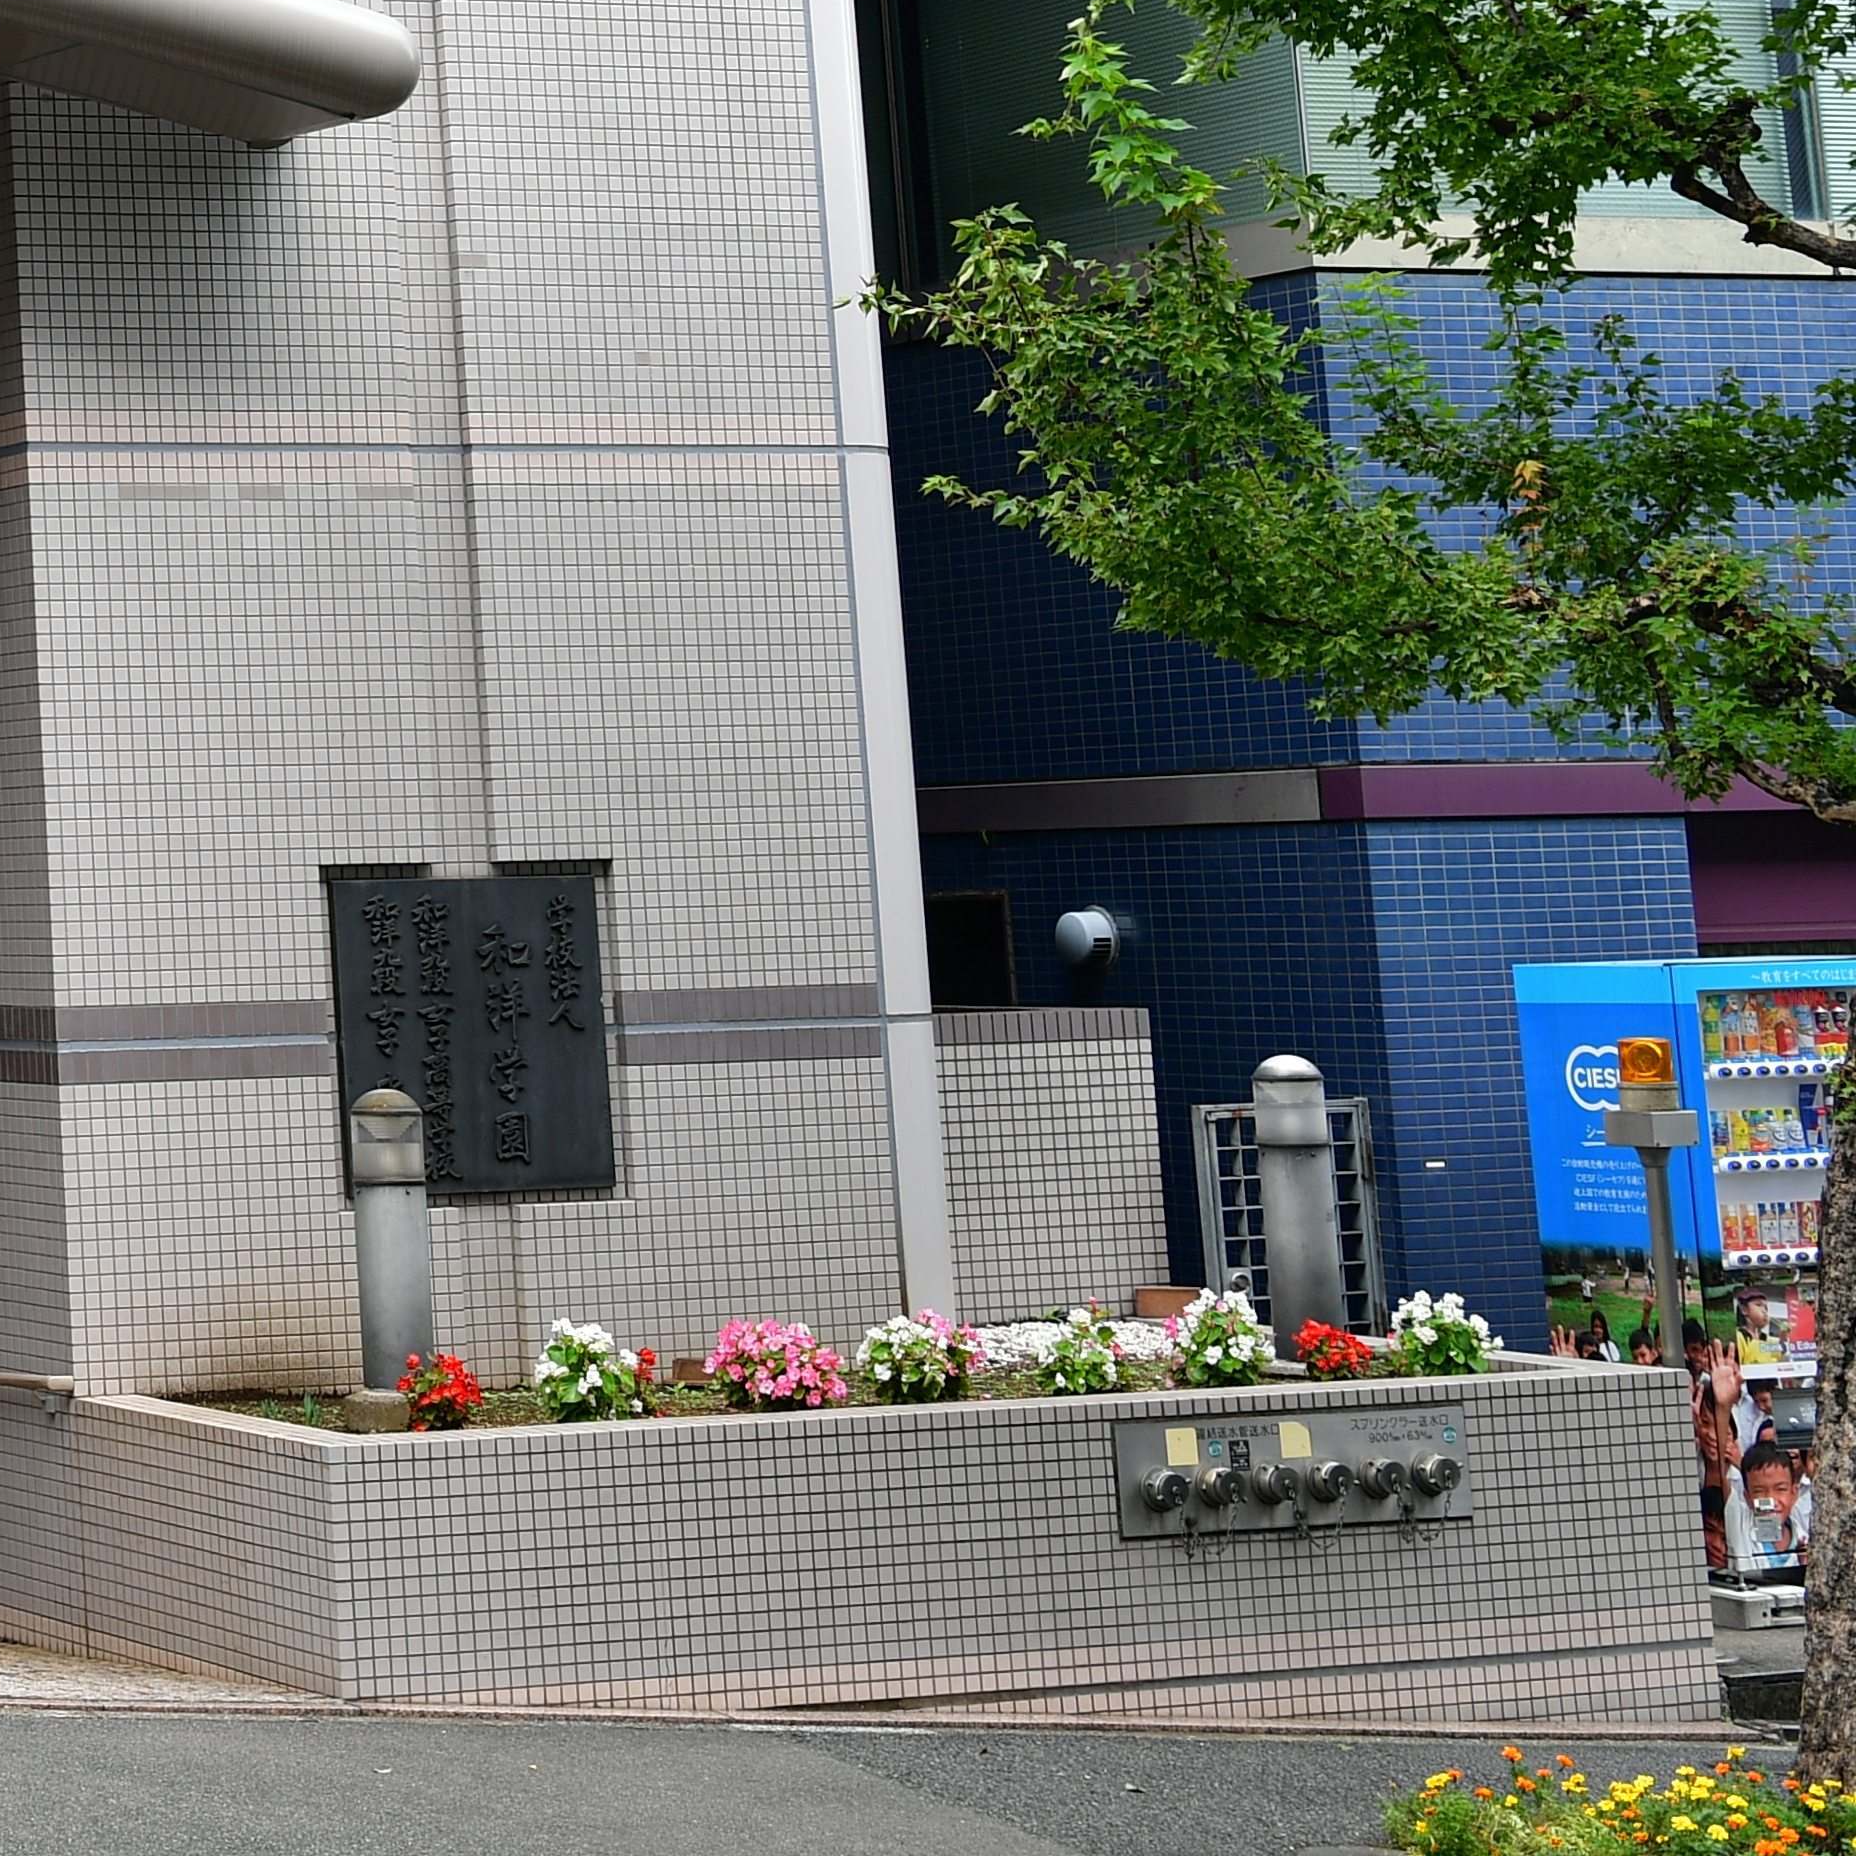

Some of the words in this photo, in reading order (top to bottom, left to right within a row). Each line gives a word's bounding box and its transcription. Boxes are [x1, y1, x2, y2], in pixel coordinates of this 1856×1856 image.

[362, 894, 406, 1090] 和洋九段女子
[476, 924, 531, 1164] 和洋学園
[544, 894, 585, 1031] 学校法人
[1573, 1067, 1620, 1089] CIES
